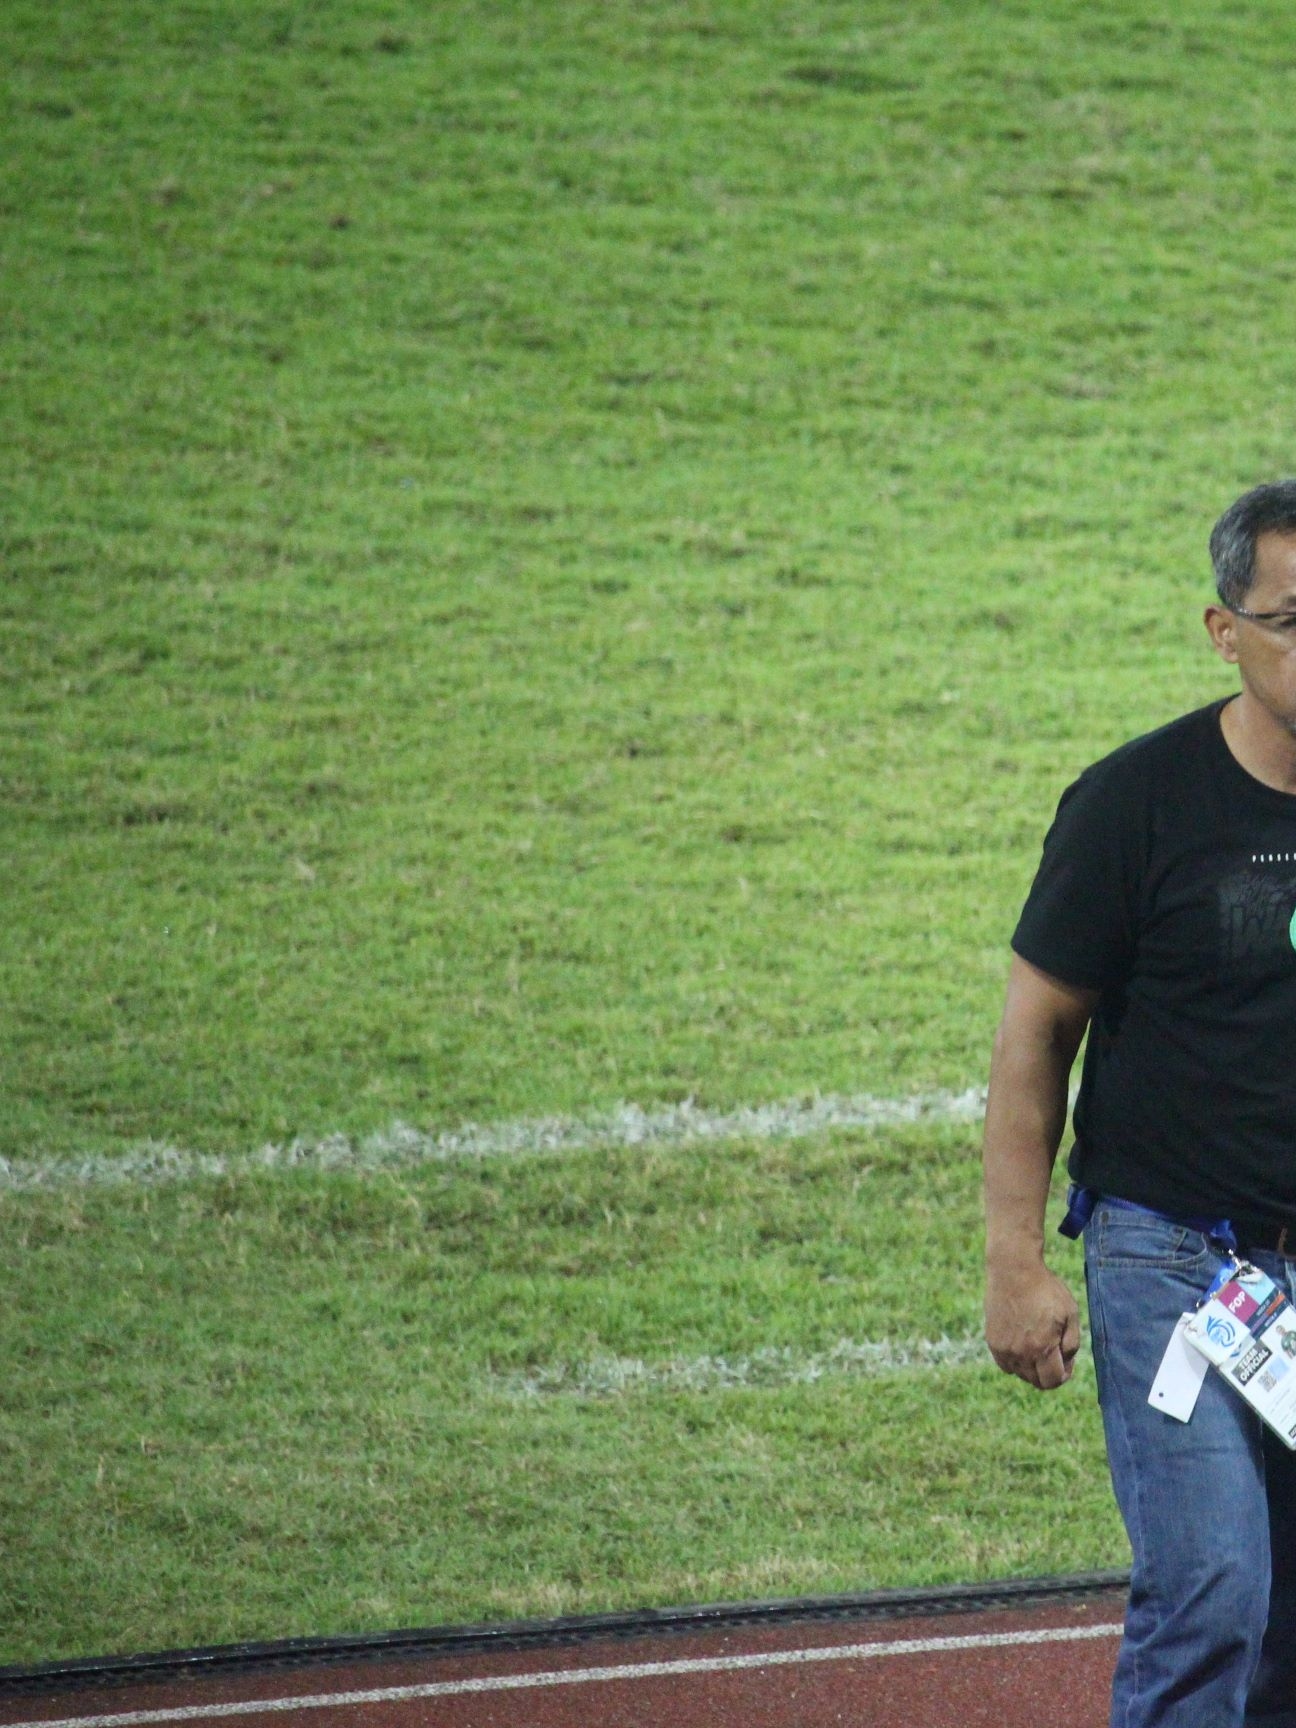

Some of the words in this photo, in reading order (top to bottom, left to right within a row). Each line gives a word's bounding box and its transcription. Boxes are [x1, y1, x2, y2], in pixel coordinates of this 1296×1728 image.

[1228, 1291, 1247, 1313] FOP
[1239, 1347, 1259, 1370] TEAM
[1240, 1349, 1269, 1382] OFFICIAL
